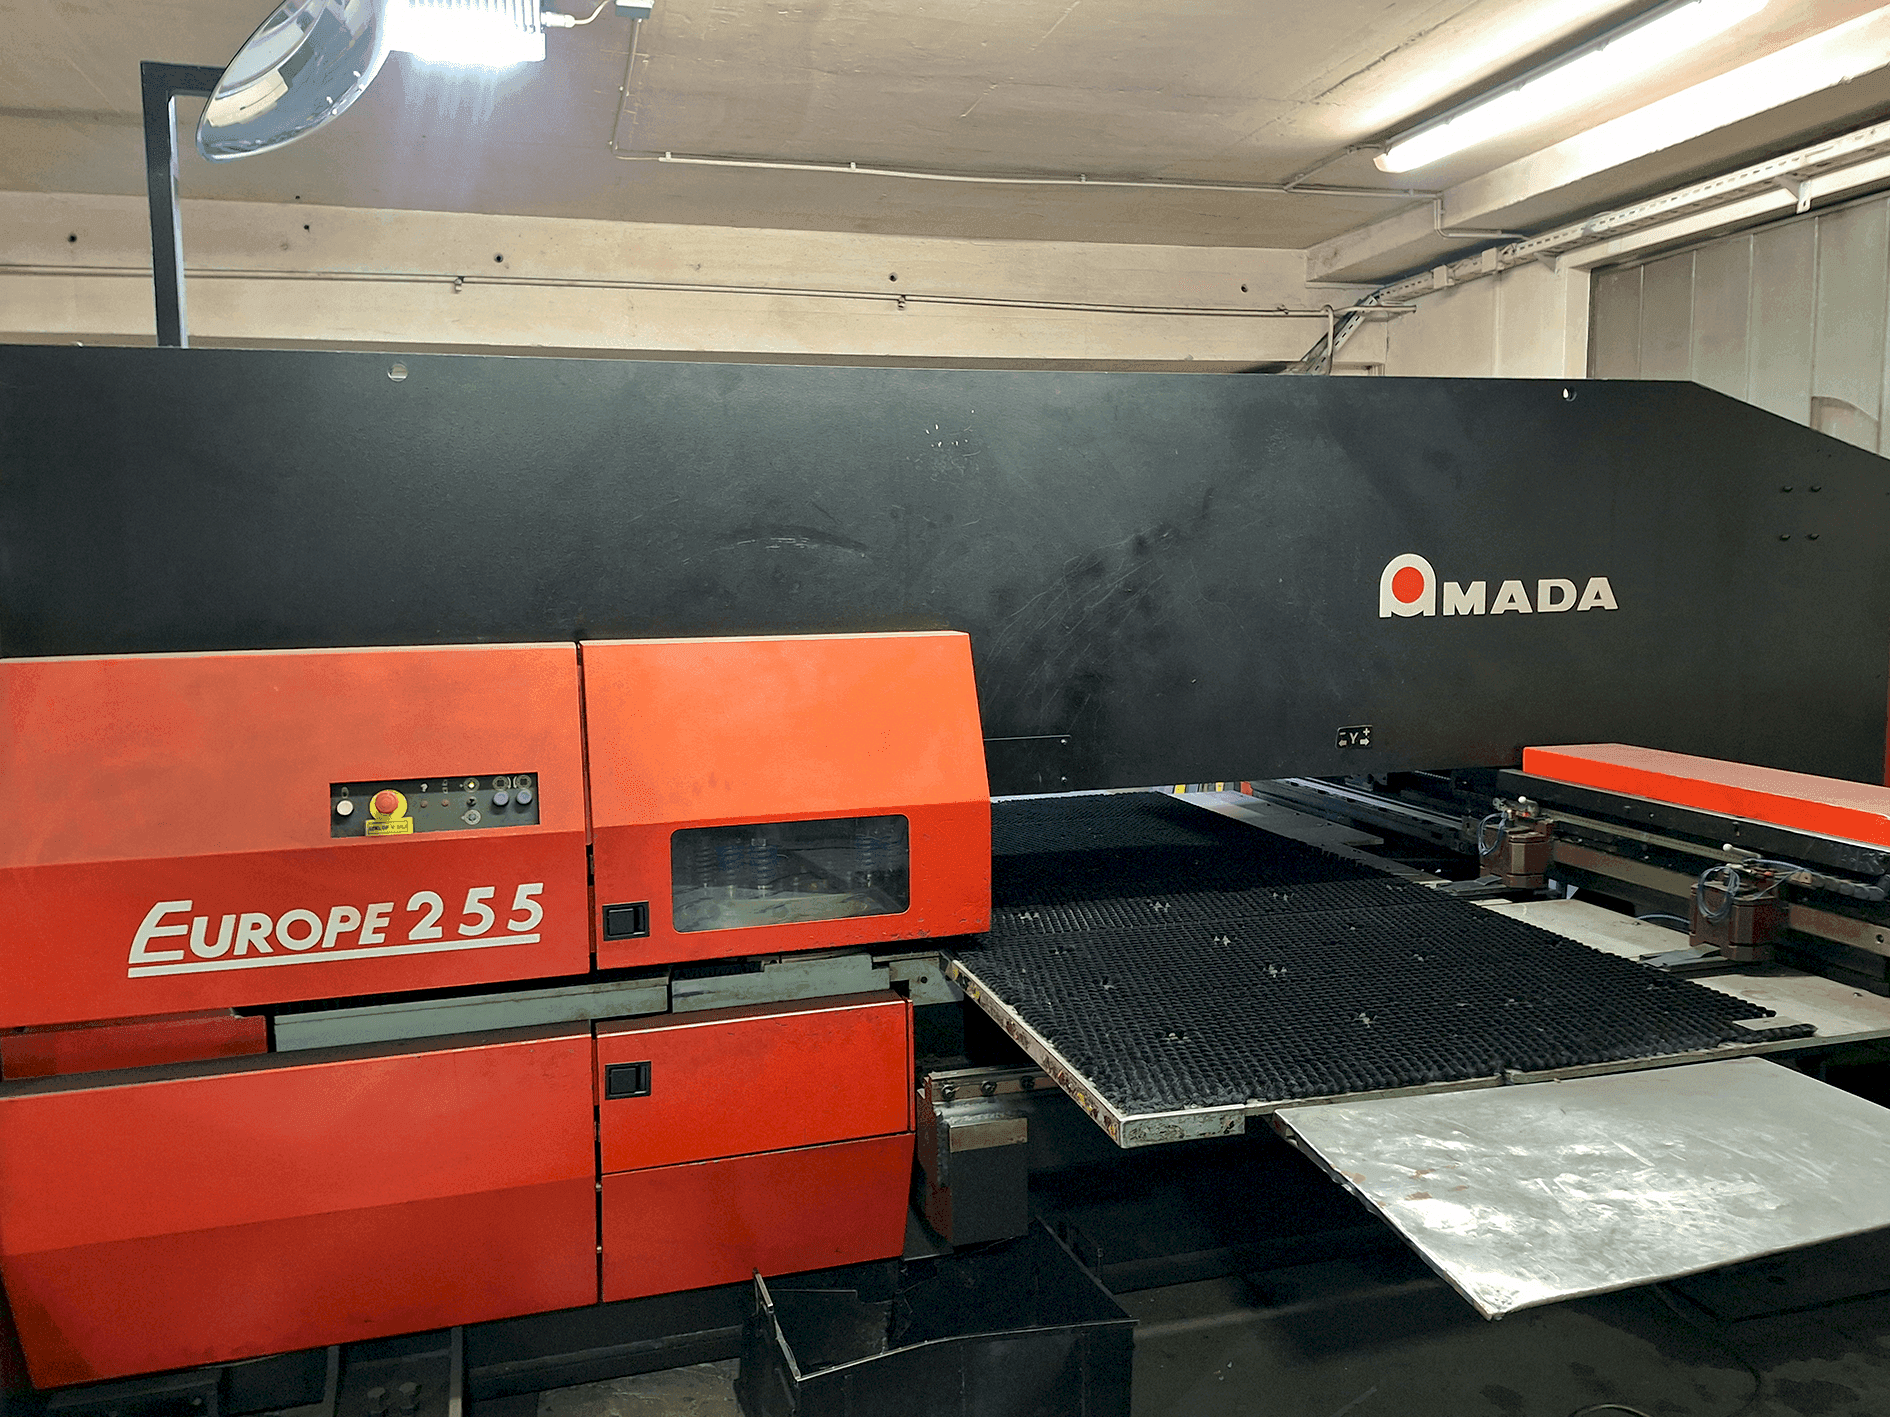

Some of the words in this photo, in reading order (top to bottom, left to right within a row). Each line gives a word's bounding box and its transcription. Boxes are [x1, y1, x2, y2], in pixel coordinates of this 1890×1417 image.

[1379, 552, 1619, 618] AMADA
[1349, 731, 1359, 745] Y
[128, 900, 395, 964] EUROPE
[406, 882, 544, 940] 255
